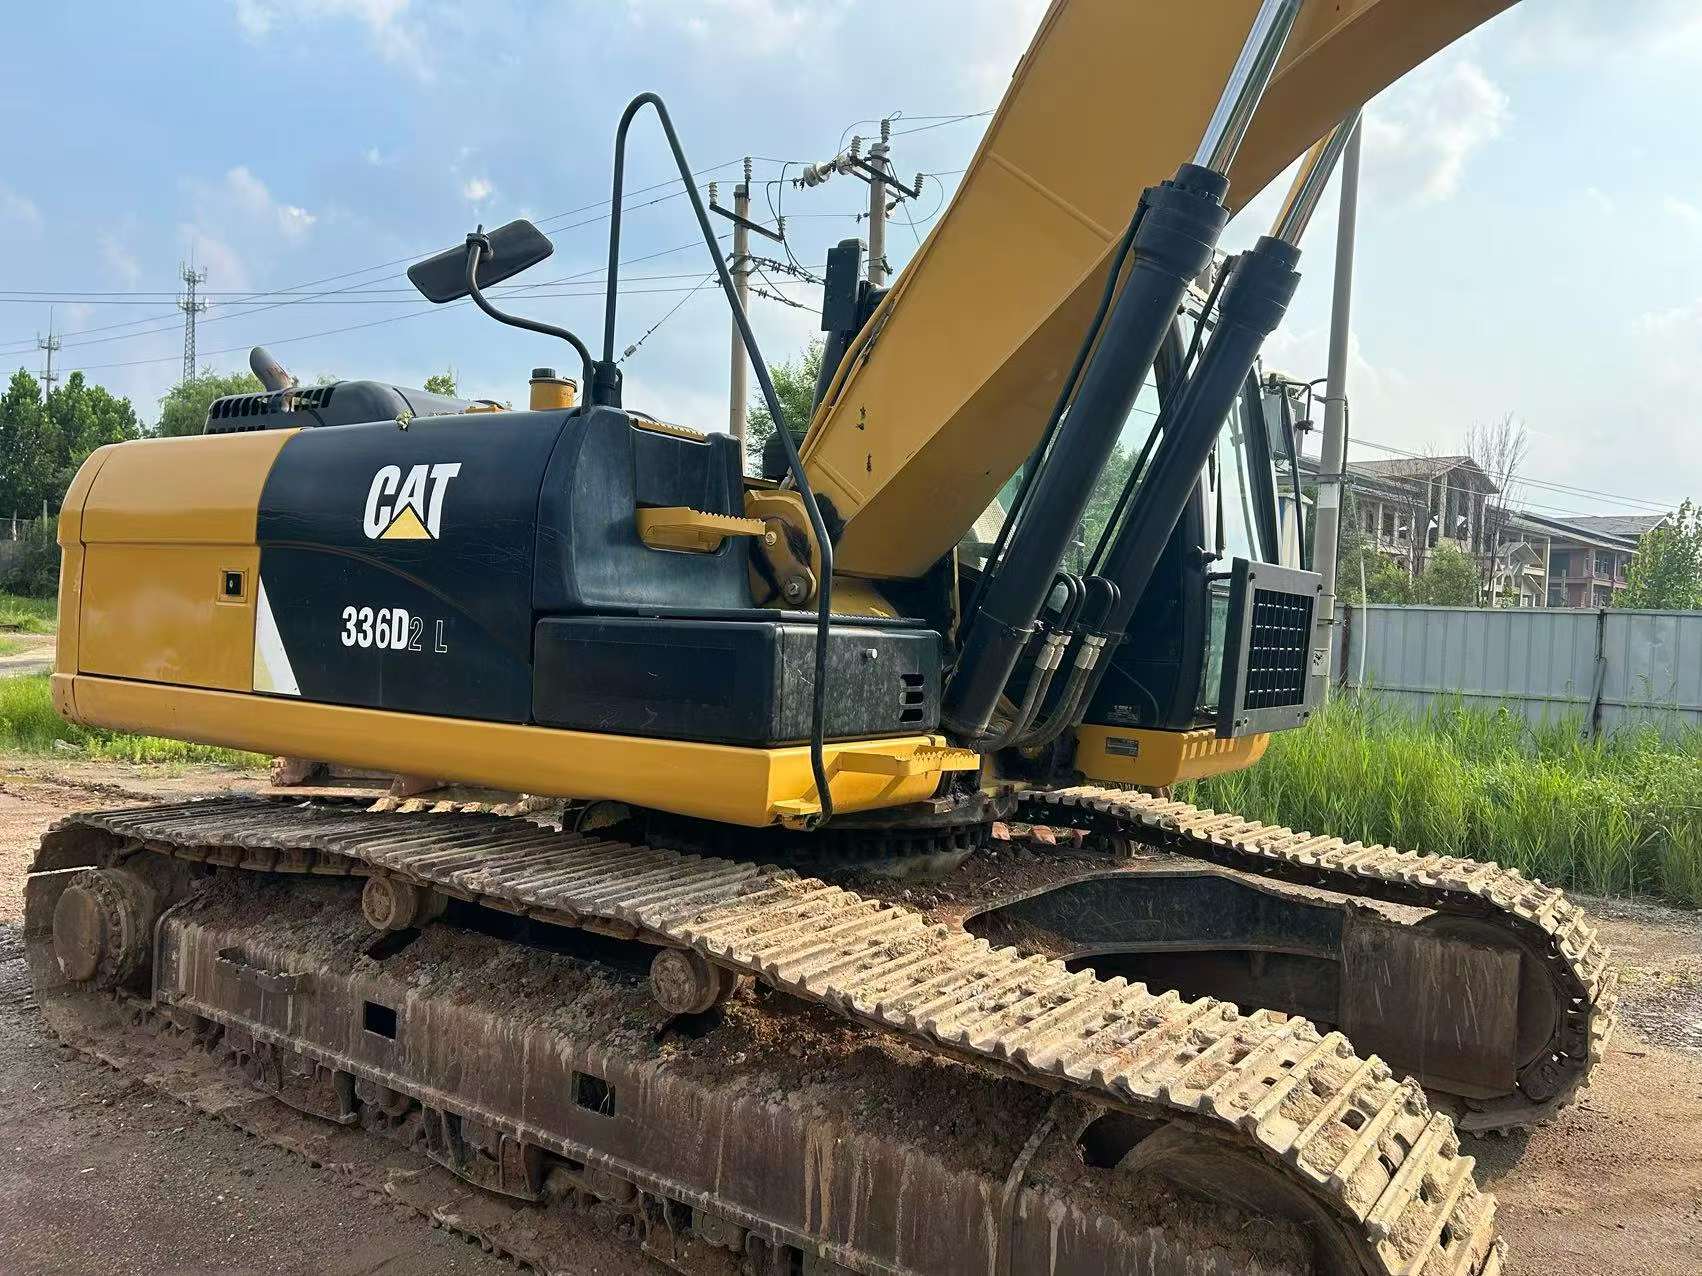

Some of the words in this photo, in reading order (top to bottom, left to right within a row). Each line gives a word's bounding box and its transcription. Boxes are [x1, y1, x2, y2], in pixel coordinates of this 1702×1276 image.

[363, 463, 462, 540] CAT
[341, 606, 424, 652] 336D2
[434, 619, 448, 653] L
